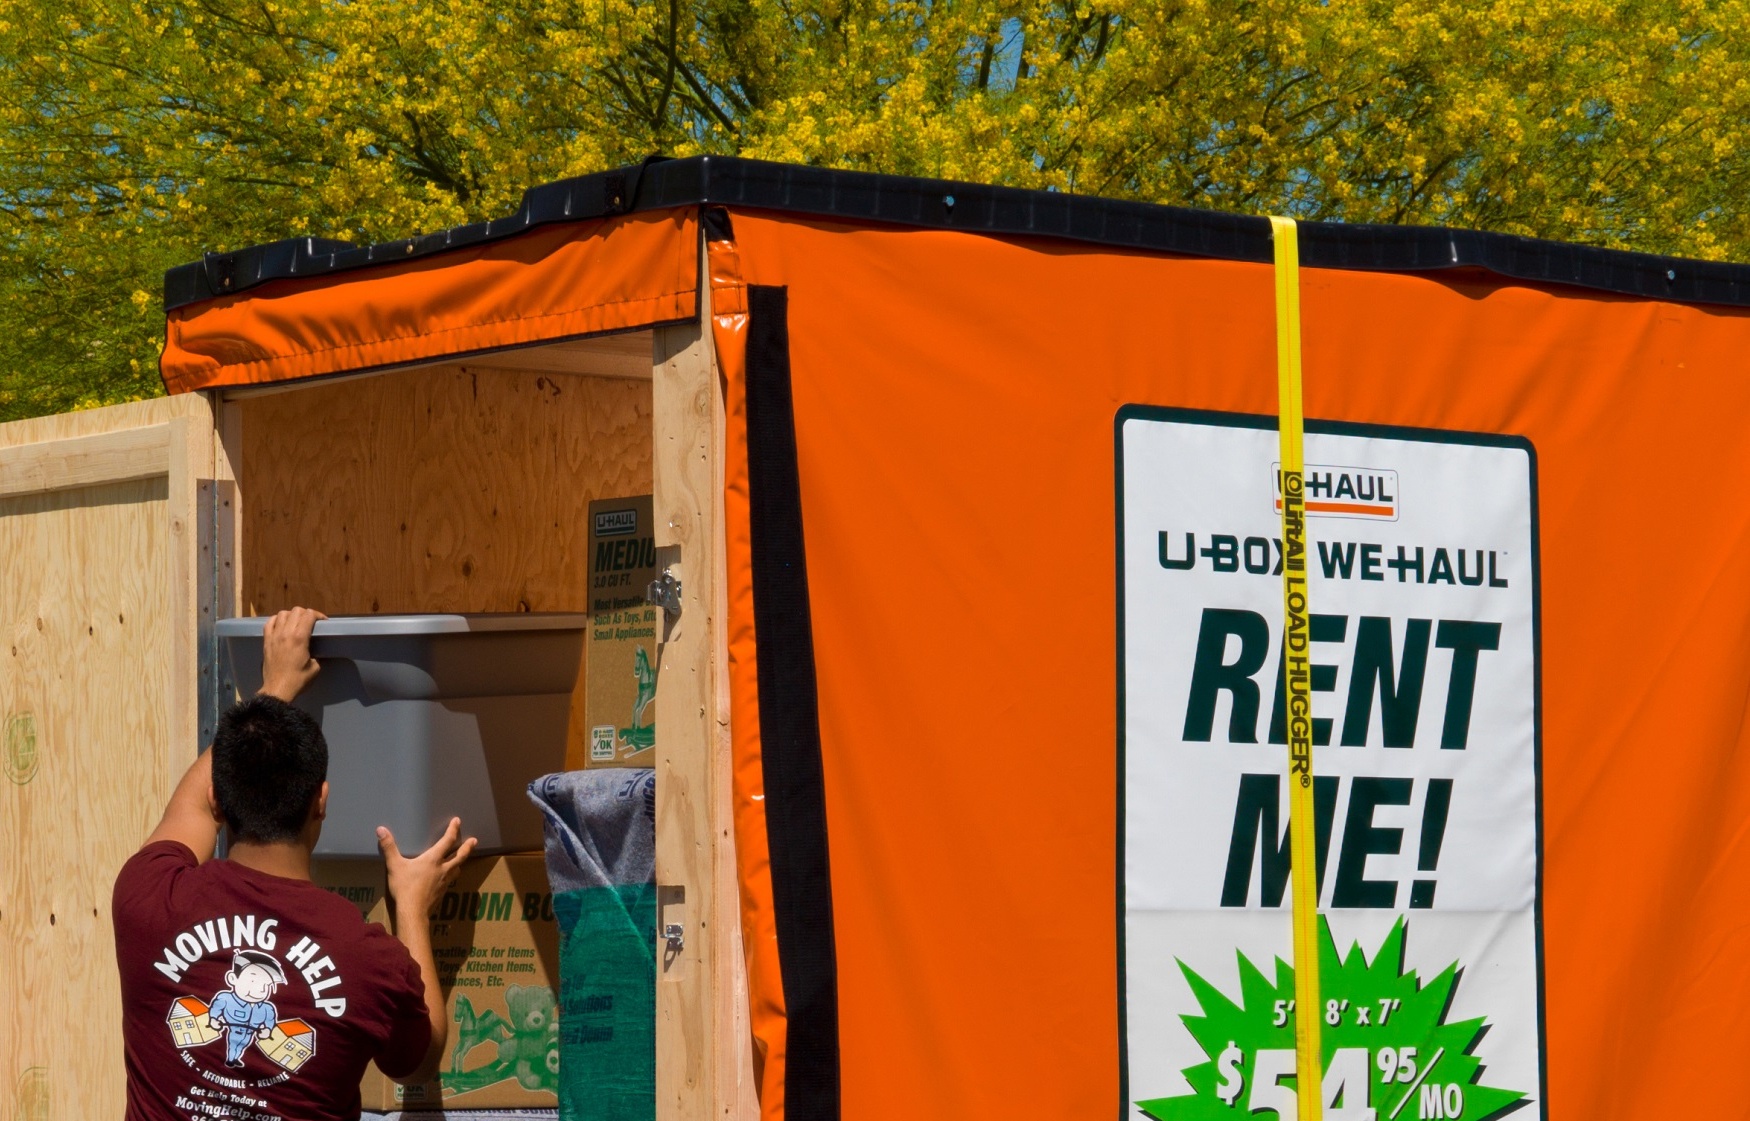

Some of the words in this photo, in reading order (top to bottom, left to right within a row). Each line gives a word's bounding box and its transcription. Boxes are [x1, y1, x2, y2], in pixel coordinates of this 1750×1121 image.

[1278, 469, 1393, 502] -HAUL
[597, 513, 635, 528] U-HAUL
[594, 537, 657, 572] MEDIU
[1316, 540, 1509, 588] WE-HAUL
[594, 574, 607, 589] 3.0
[607, 573, 619, 588] CU
[594, 614, 611, 626] Such
[612, 612, 622, 625] As
[623, 611, 641, 625] Toys,
[1286, 577, 1308, 653] LOAD
[593, 628, 613, 641] Small
[614, 627, 657, 641] Appliances,
[1182, 607, 1503, 751] RENT
[600, 739, 613, 750] OK
[1219, 772, 1454, 909] ME!
[431, 892, 514, 922] DIUM
[469, 946, 489, 958] Box
[490, 946, 505, 958] for
[507, 946, 536, 958] Items
[153, 915, 278, 983] MOVING
[285, 936, 347, 1018] HELP
[439, 961, 463, 974] Toys,
[466, 960, 503, 973] Kitchen
[506, 960, 537, 974] Items,
[486, 976, 505, 987] Etc.
[1356, 1006, 1371, 1025] x
[180, 1050, 196, 1068] SAFE
[202, 1070, 246, 1089] AFFORDABLE
[257, 1071, 290, 1088] RELIABLE
[190, 1086, 206, 1097] Get
[208, 1089, 227, 1101] Help
[230, 1094, 256, 1108] Today
[258, 1099, 268, 1108] at
